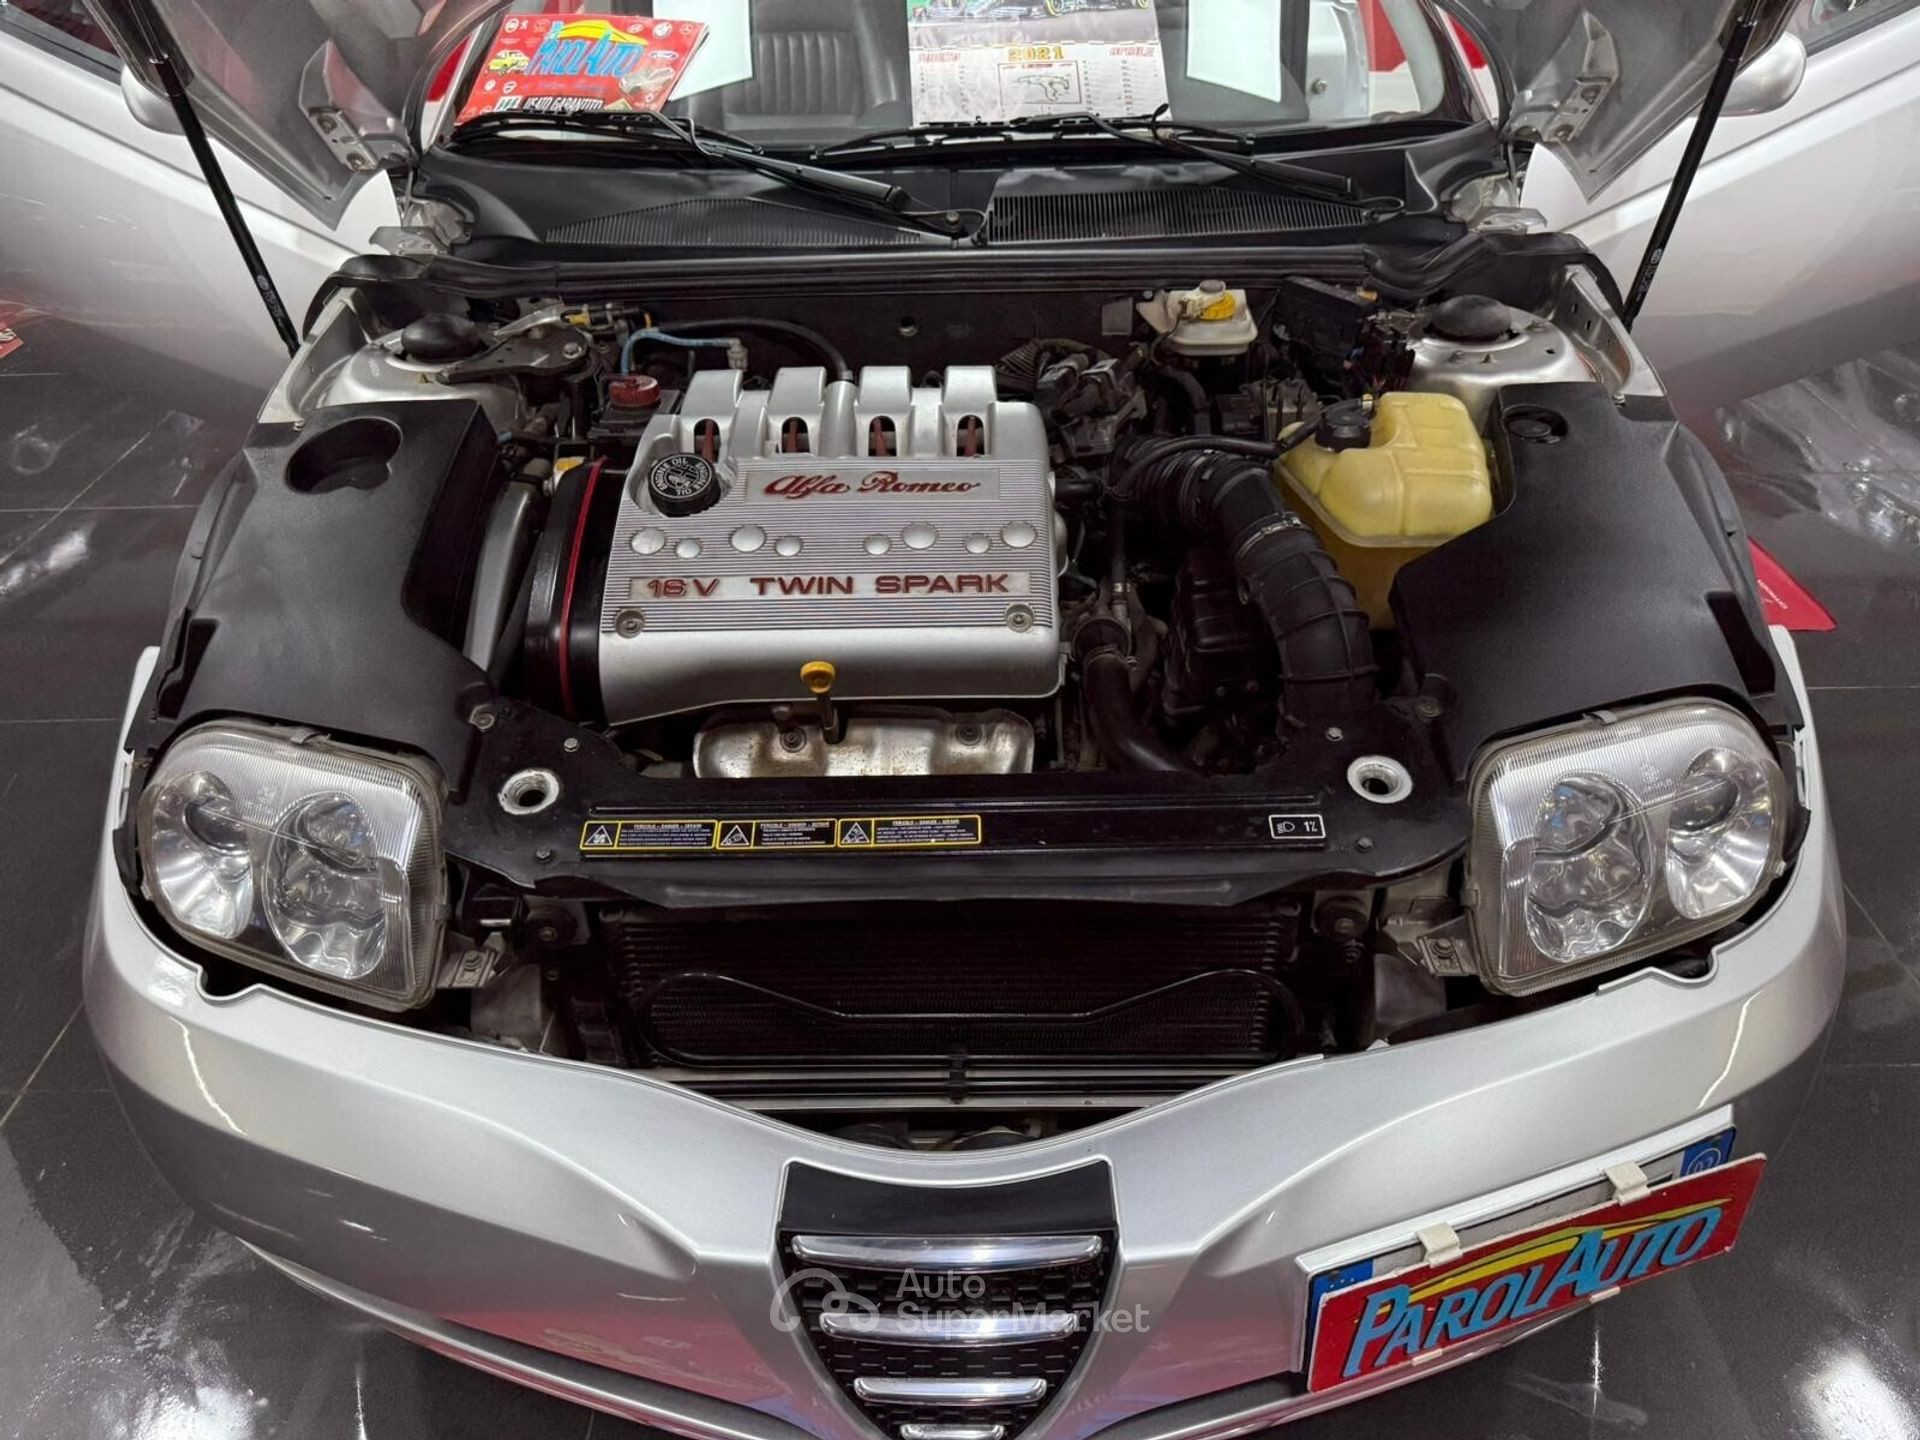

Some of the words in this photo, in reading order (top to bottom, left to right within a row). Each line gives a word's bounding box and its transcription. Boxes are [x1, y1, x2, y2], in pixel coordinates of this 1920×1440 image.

[1007, 46, 1065, 61] 2021
[671, 457, 688, 466] OIL
[763, 473, 850, 500] Alfa
[857, 470, 981, 493] Romeo
[750, 576, 853, 596] TWIN
[874, 573, 1010, 594] SPARK
[1342, 1206, 1722, 1378] PAROLAUTO
